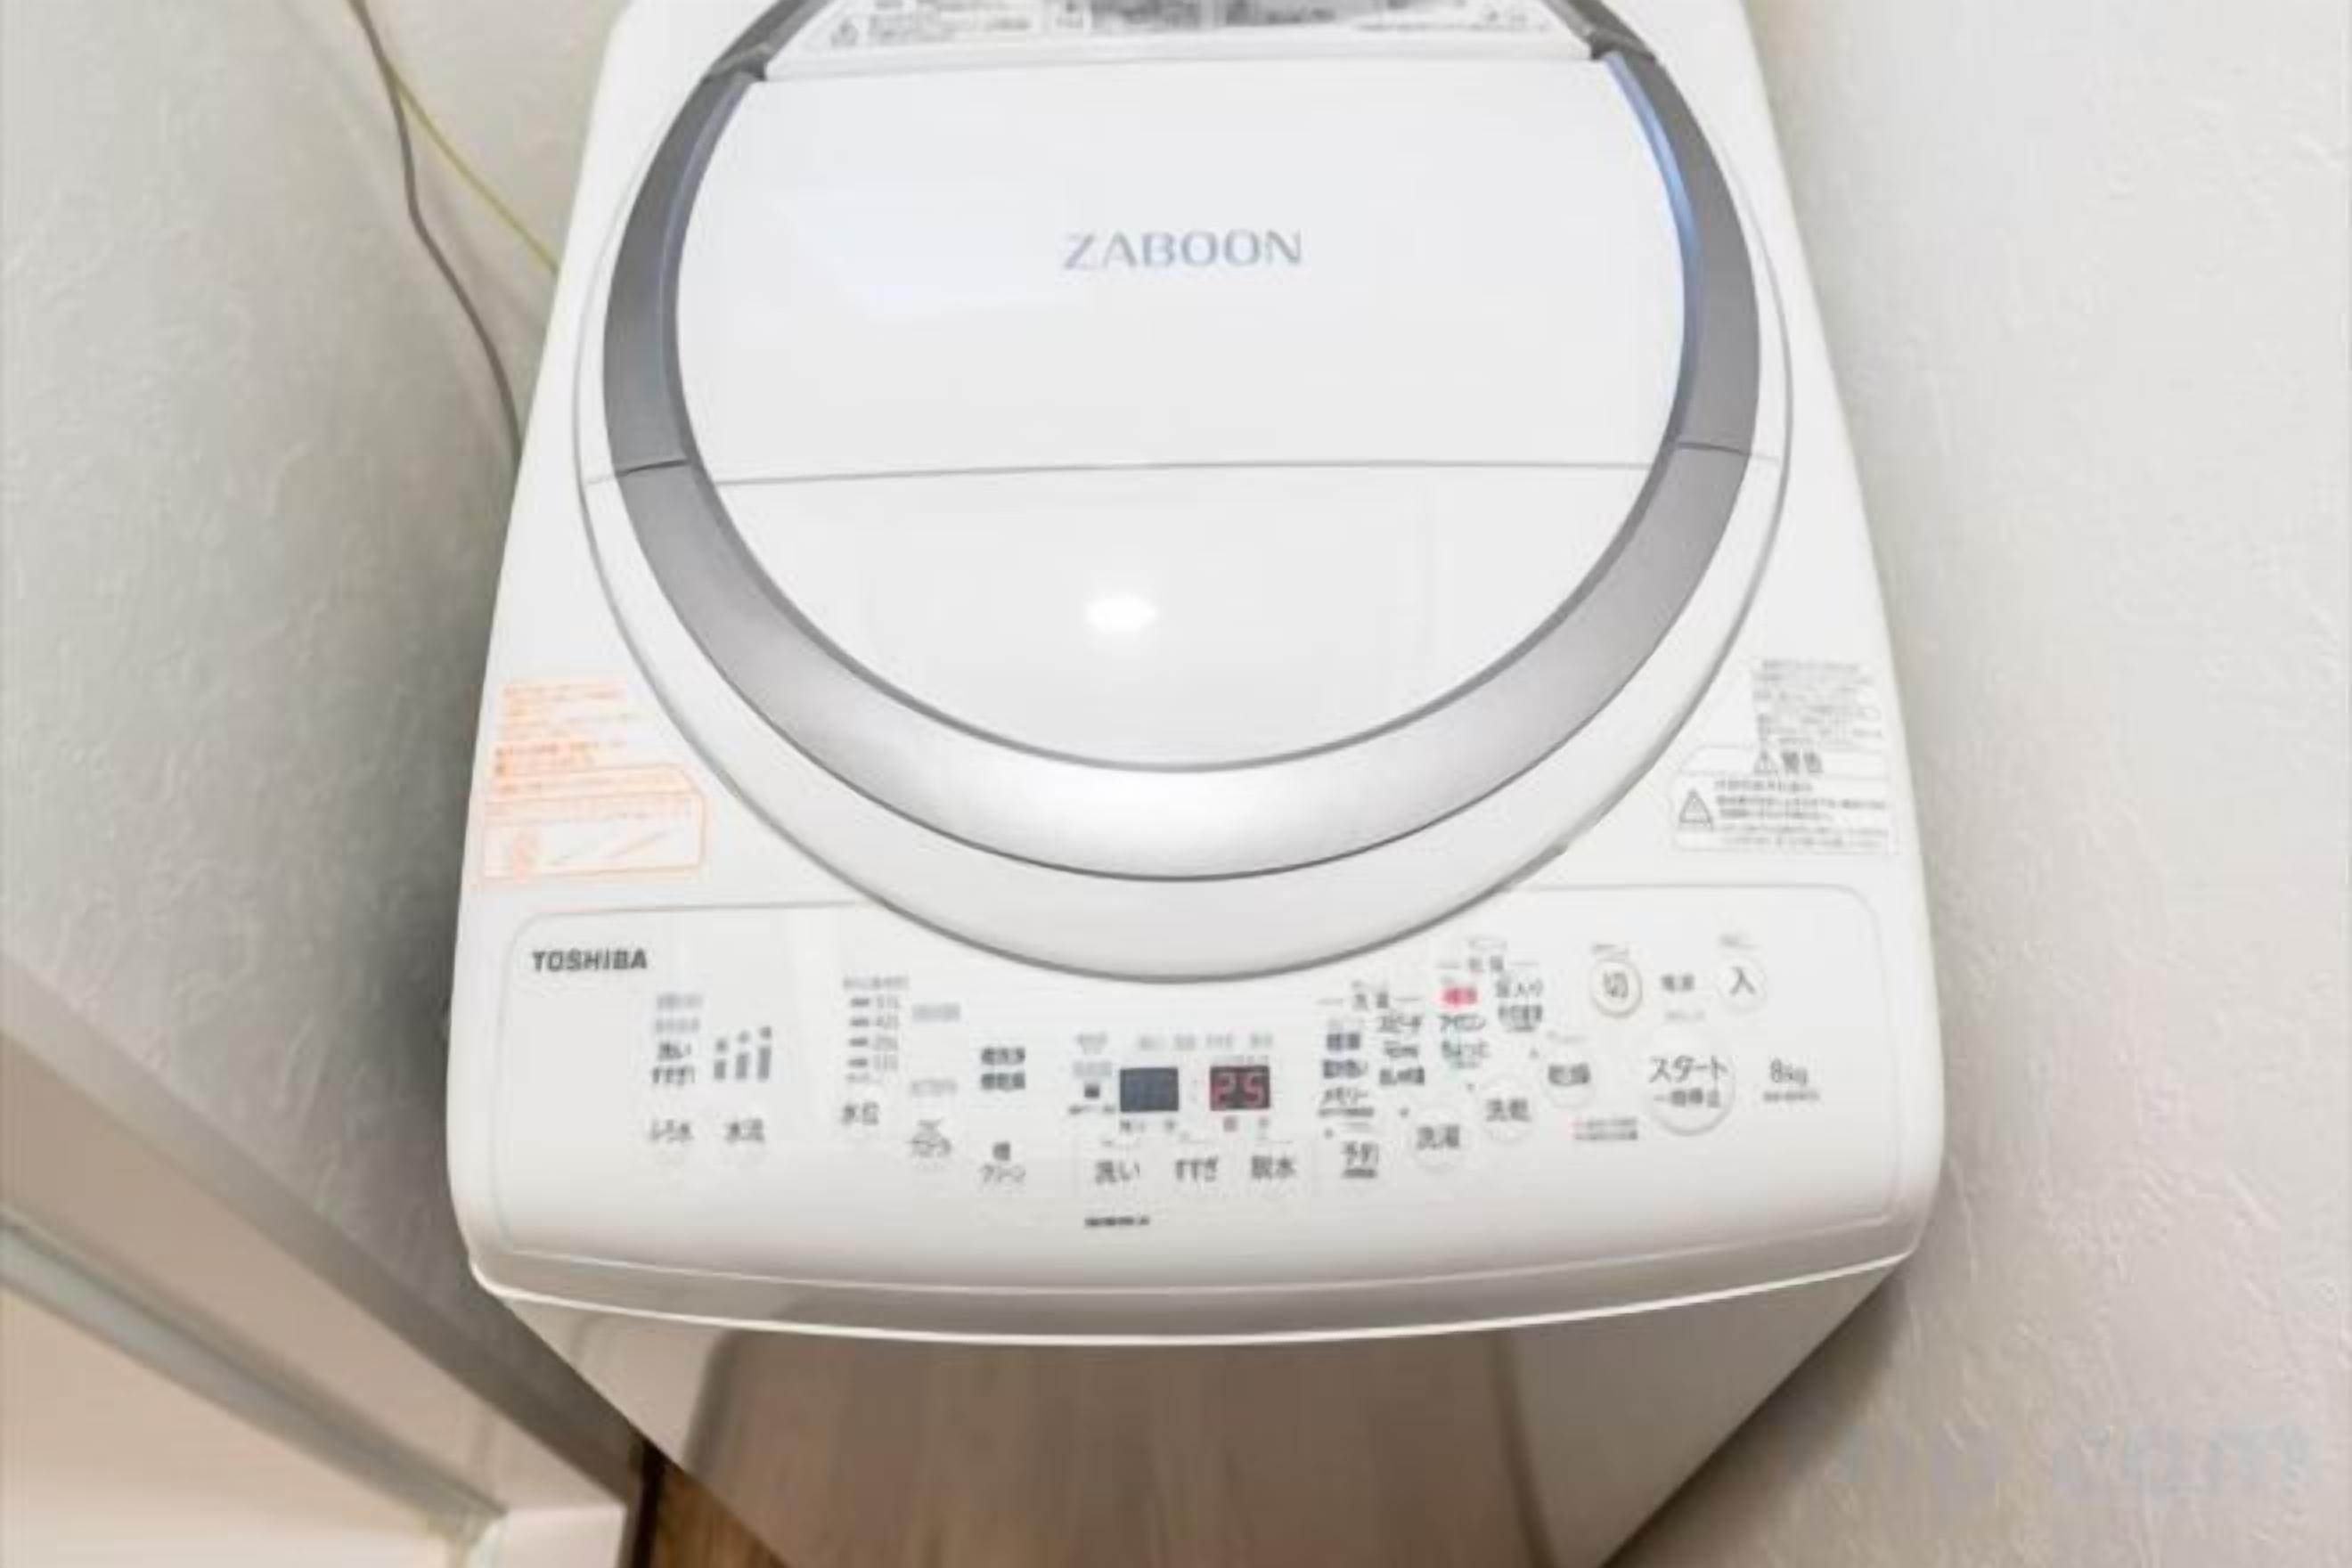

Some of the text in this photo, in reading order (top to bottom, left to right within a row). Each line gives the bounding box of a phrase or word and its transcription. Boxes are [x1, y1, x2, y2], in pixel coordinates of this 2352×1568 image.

[1062, 228, 1303, 273] ZABOON
[531, 948, 649, 972] TOSHIBA
[1604, 972, 1629, 998] 切
[1729, 966, 1755, 995] 入
[1649, 1056, 1729, 1083] スタート
[1213, 1071, 1266, 1107] 25
[1094, 1159, 1140, 1185] 洗い
[1174, 1156, 1220, 1182] すすぎ
